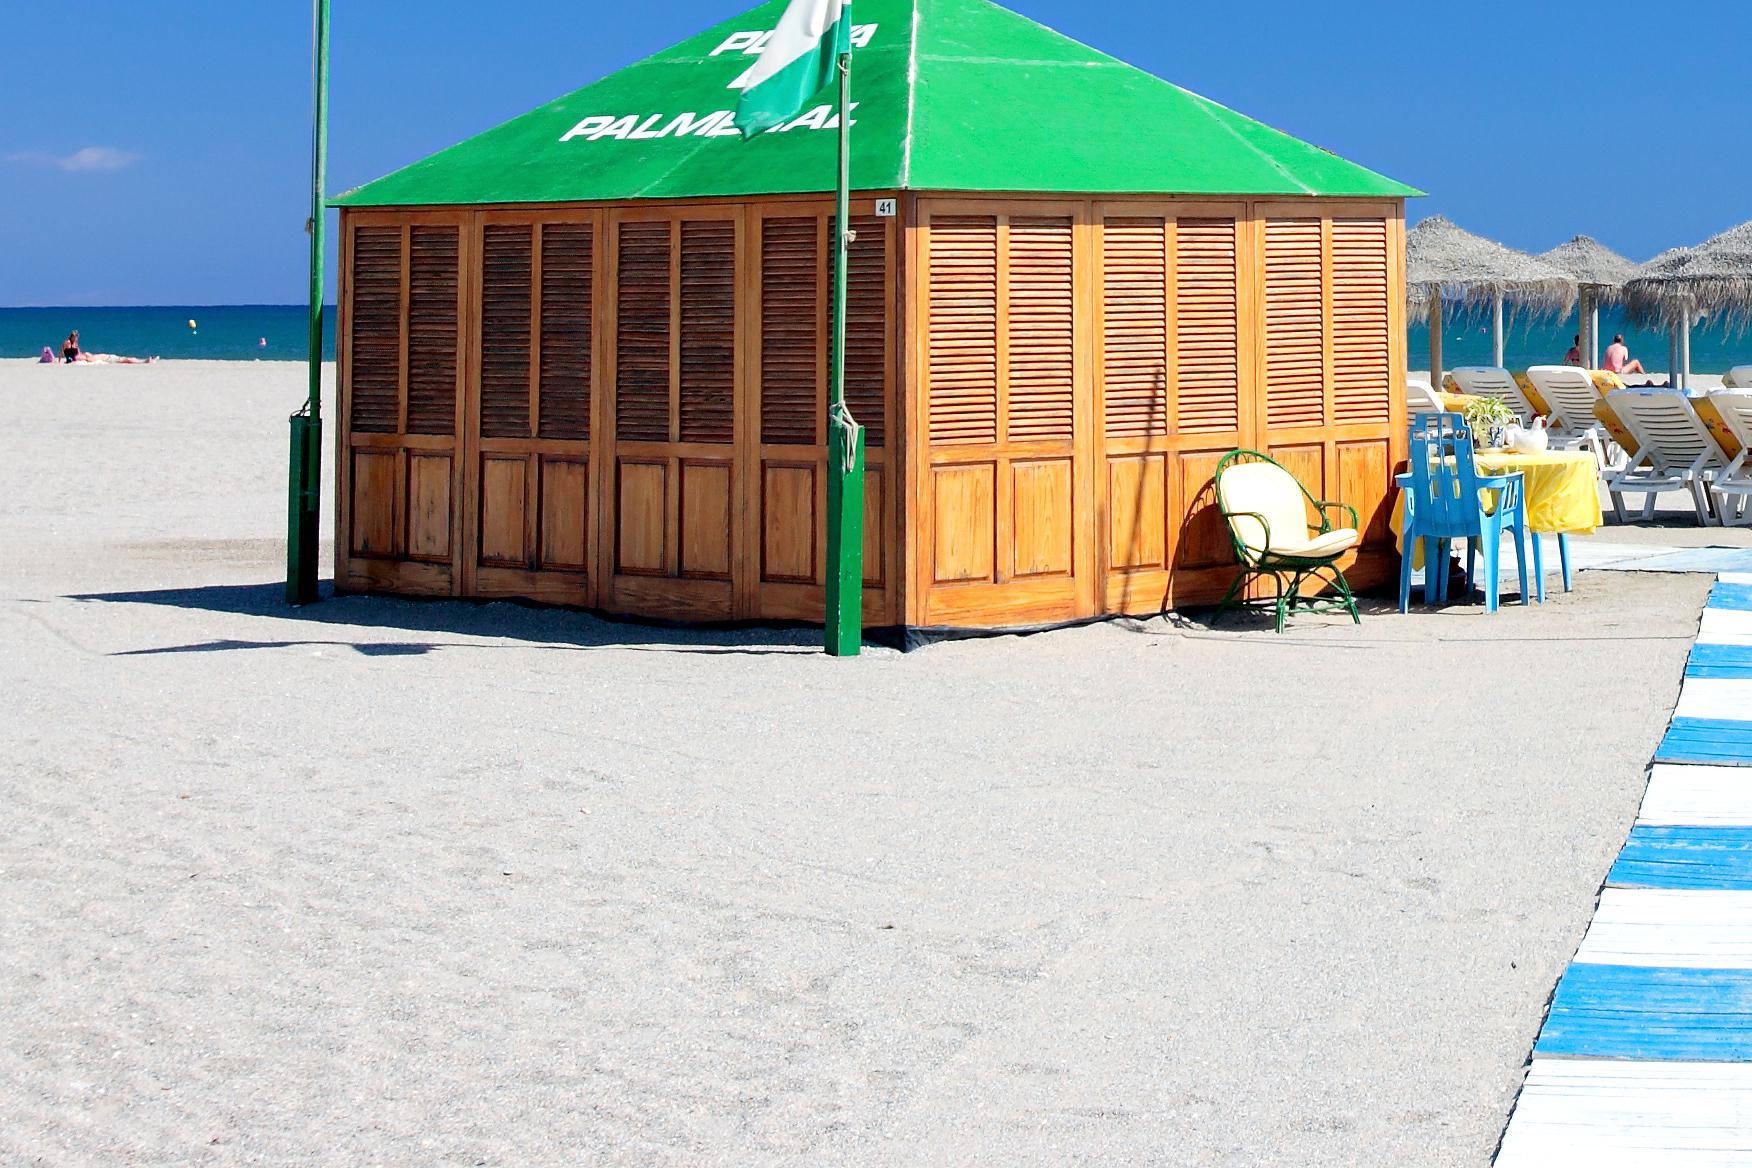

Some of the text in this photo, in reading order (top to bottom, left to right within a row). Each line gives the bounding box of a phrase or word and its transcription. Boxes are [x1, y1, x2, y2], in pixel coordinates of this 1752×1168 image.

[708, 23, 878, 56] PLA
[558, 102, 860, 141] PALMEAL
[879, 201, 891, 214] 41
